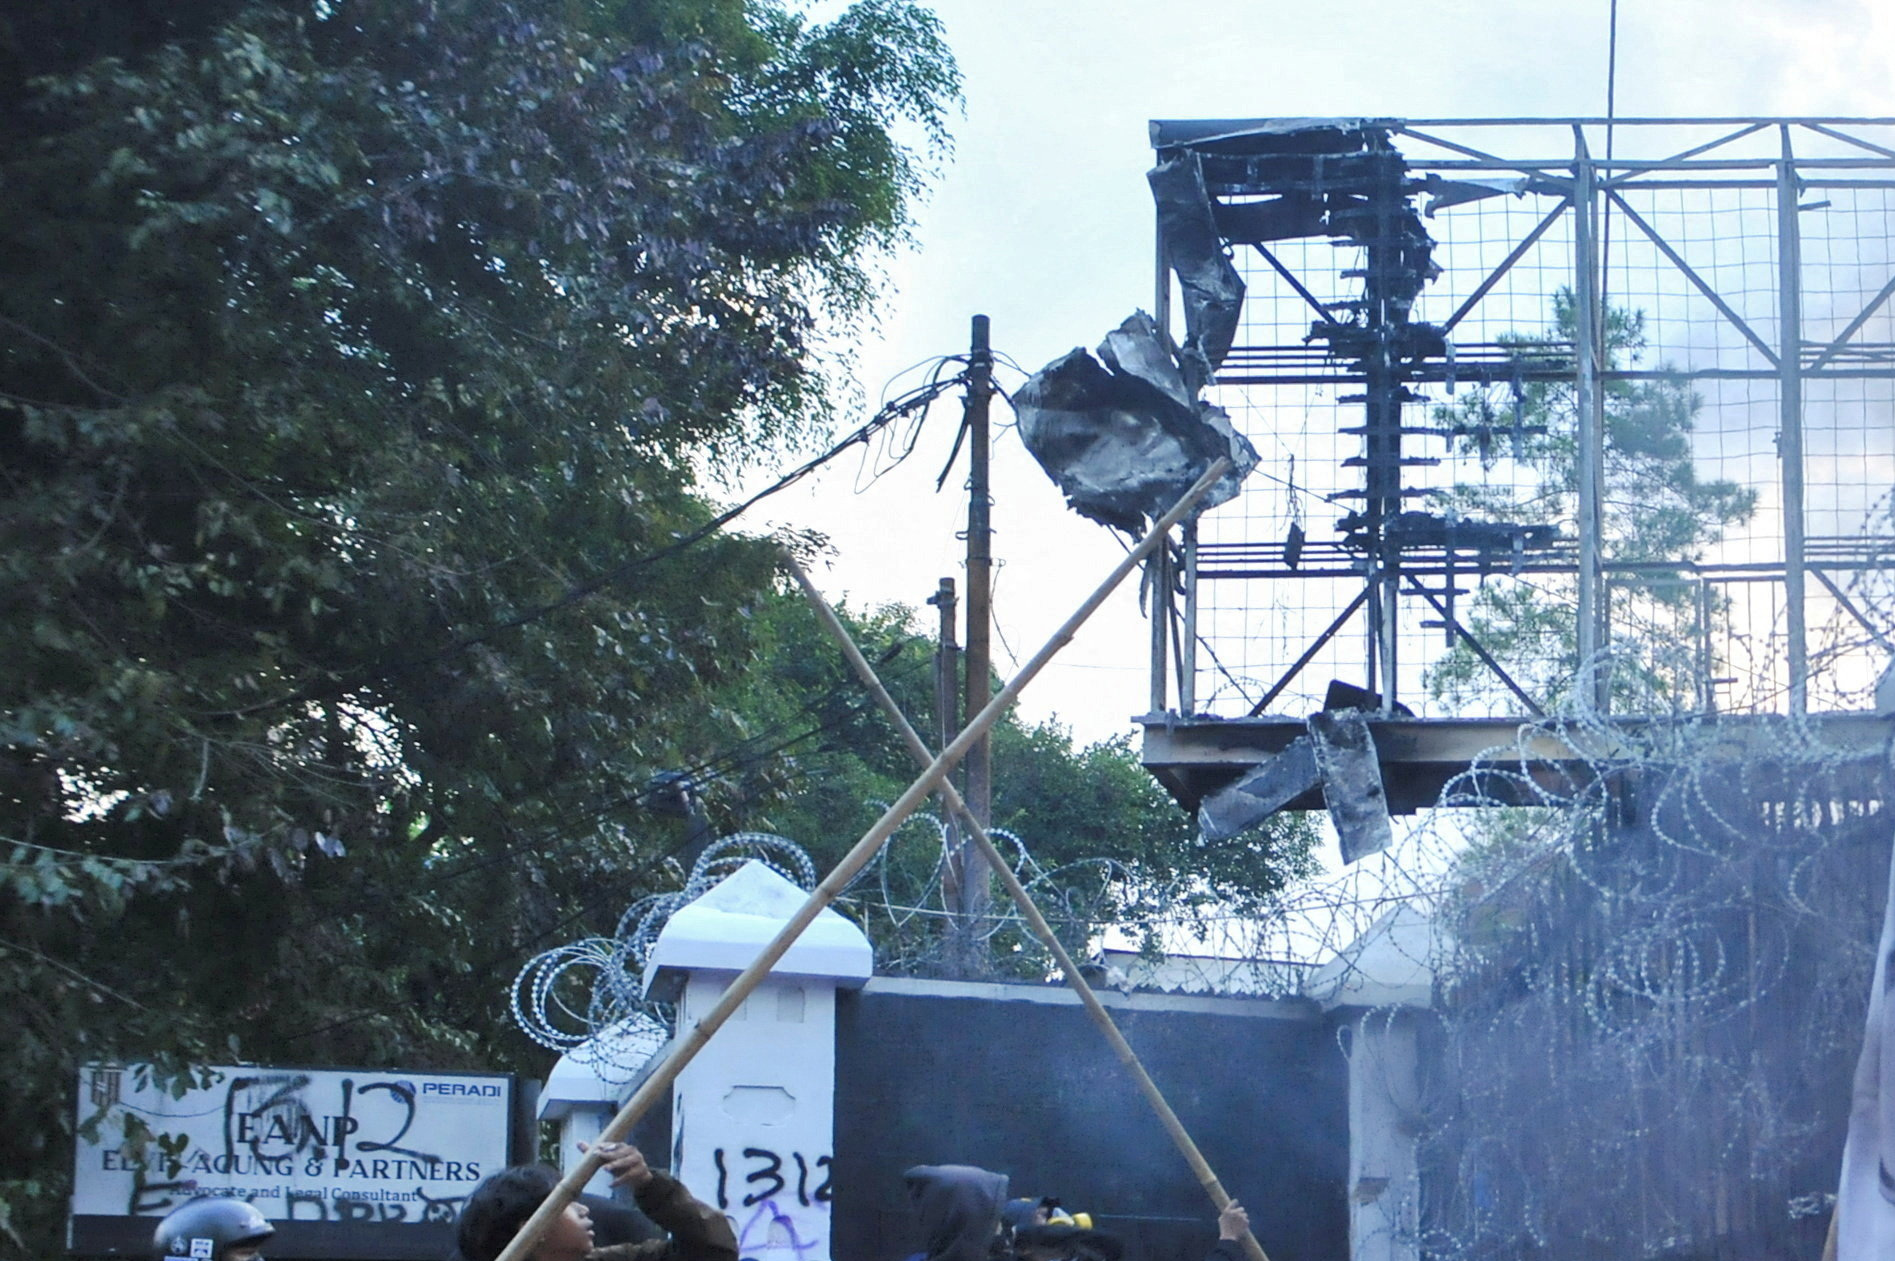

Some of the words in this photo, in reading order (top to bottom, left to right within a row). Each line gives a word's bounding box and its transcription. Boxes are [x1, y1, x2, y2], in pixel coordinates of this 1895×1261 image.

[422, 1082, 501, 1097] PERADI
[192, 1154, 294, 1177] AGUNG
[304, 1157, 323, 1177] &
[333, 1159, 481, 1182] PARTNERS
[714, 1147, 834, 1209] 1312
[251, 1185, 281, 1199] and
[331, 1187, 418, 1203] Consultant
